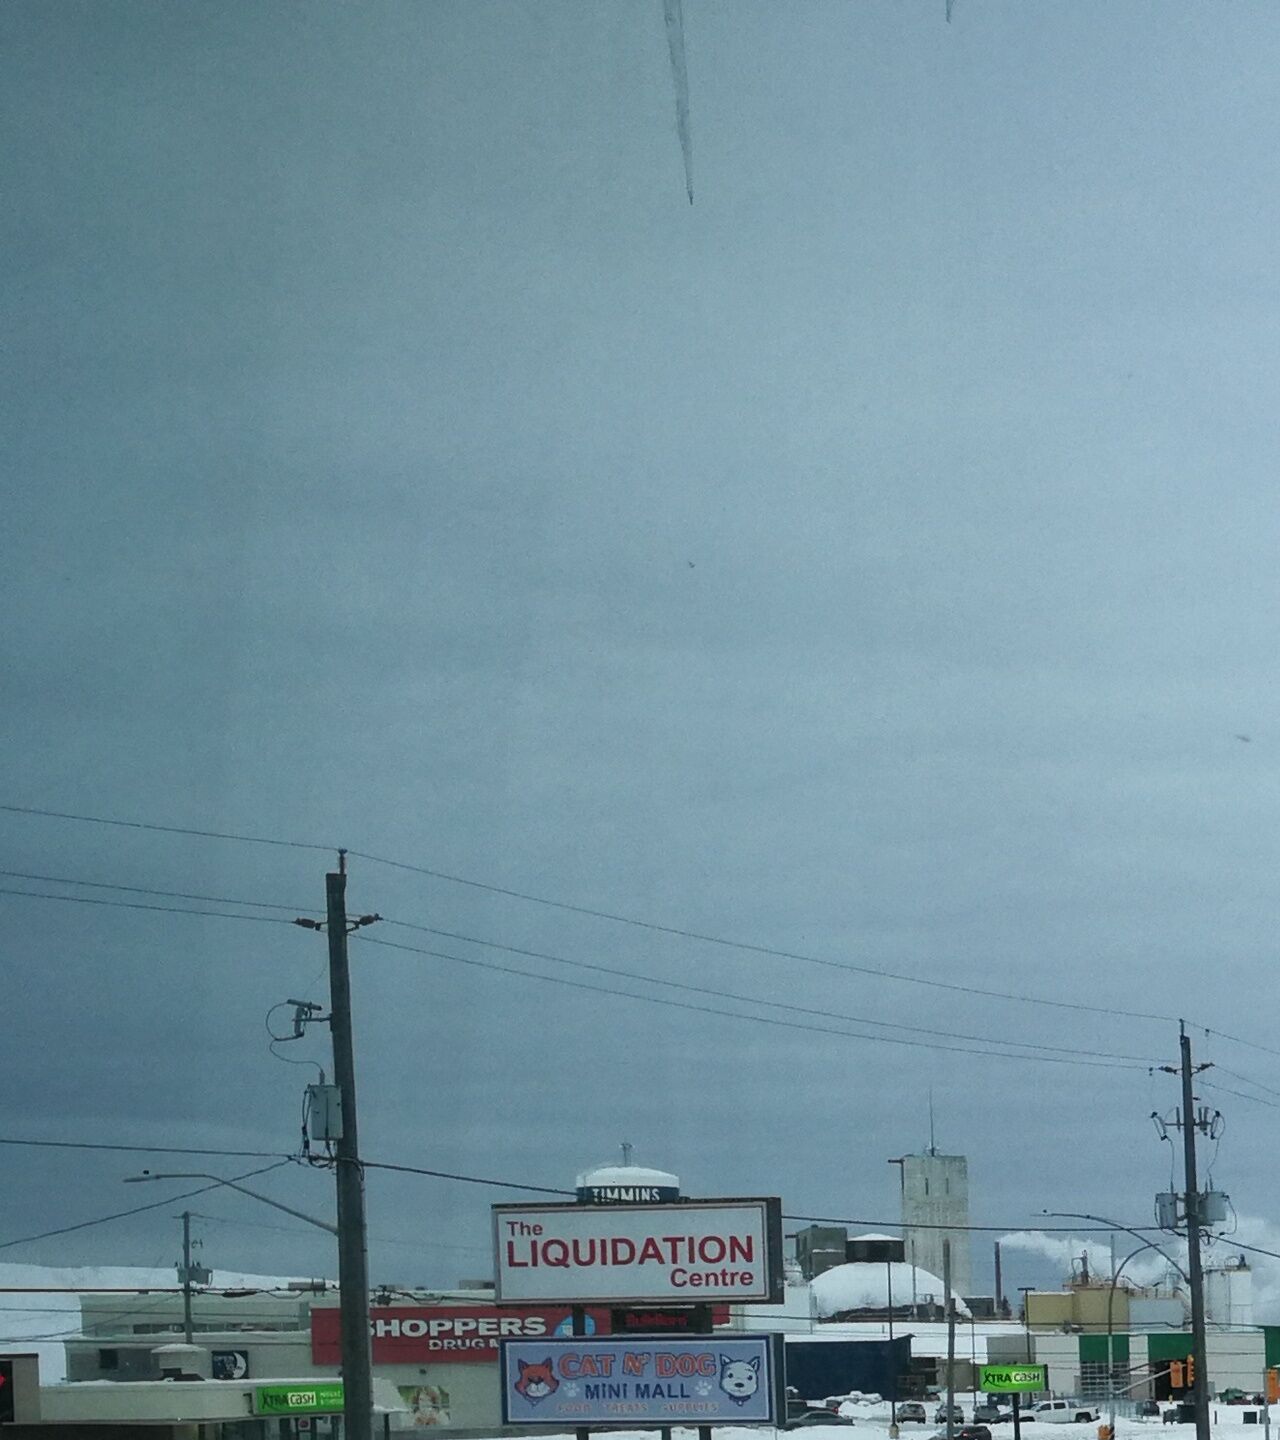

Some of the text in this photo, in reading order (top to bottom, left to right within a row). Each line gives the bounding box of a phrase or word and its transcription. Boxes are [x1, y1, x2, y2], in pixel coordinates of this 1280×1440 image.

[591, 1187, 661, 1202] TIMMINS
[506, 1221, 543, 1236] The
[506, 1235, 753, 1268] LIQUIDATION
[670, 1268, 754, 1287] Centre
[428, 1339, 485, 1350] DRUG
[558, 1352, 616, 1380] CAT
[655, 1352, 717, 1379] DOG
[635, 1383, 691, 1399] MALL
